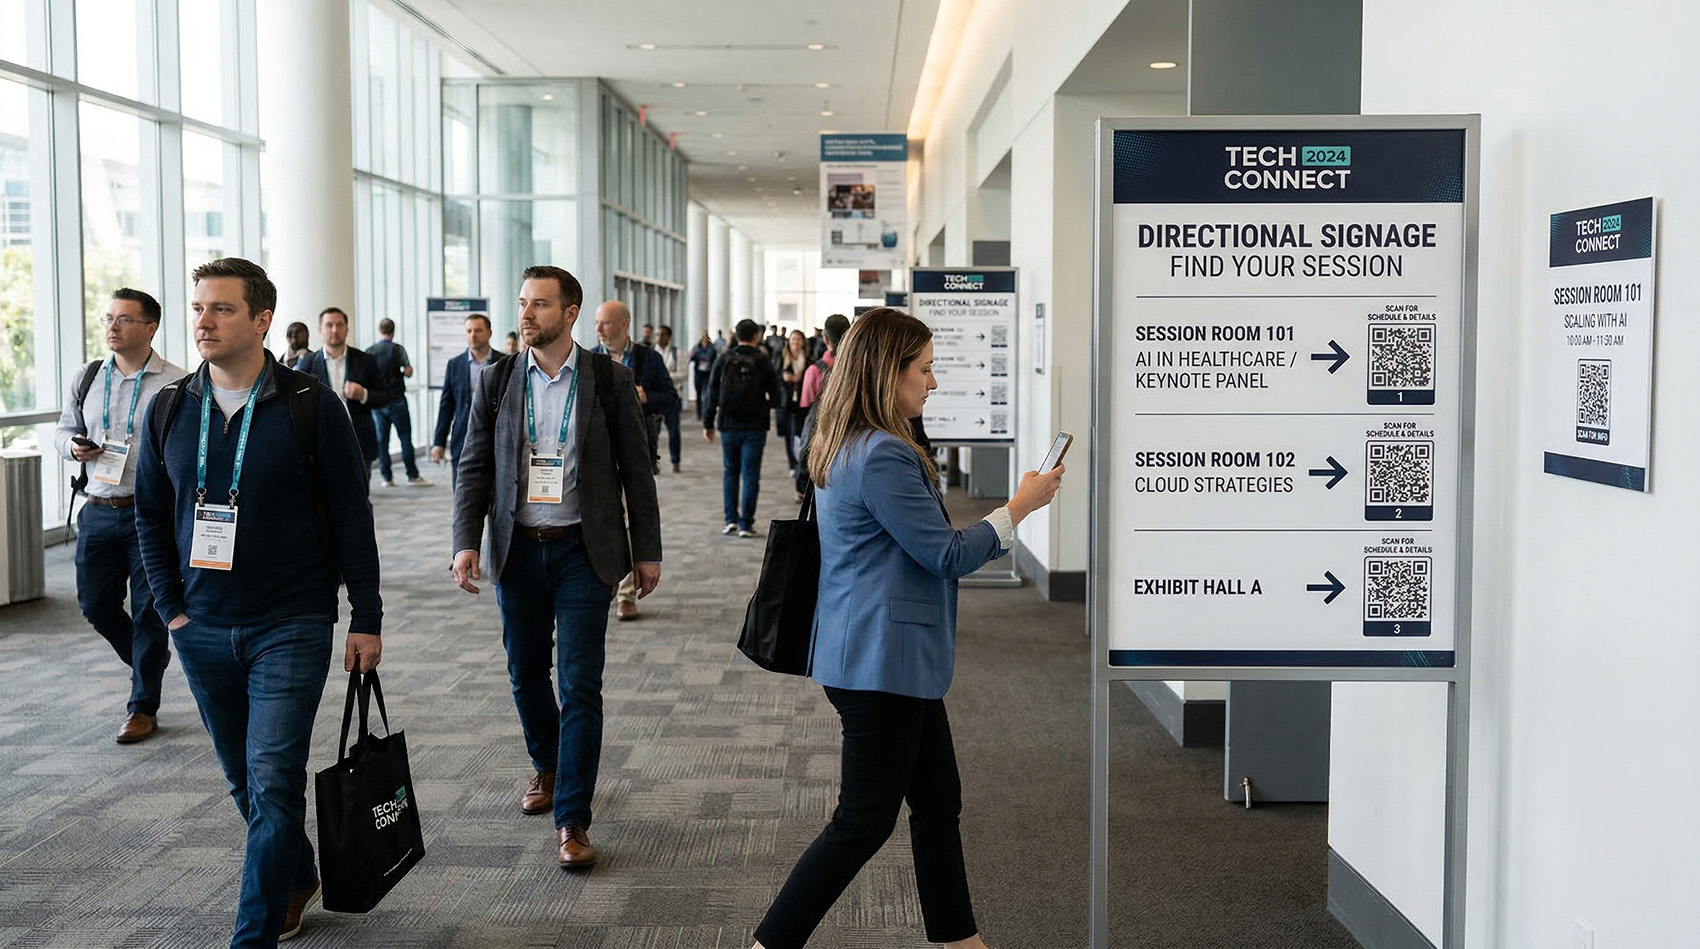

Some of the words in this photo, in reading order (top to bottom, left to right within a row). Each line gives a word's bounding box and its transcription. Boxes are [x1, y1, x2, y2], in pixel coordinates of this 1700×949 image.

[1225, 146, 1296, 167] TECH
[1306, 150, 1347, 163] 2024
[1224, 169, 1351, 189] CONNECT
[1575, 218, 1602, 236] TECH
[1138, 224, 1312, 249] DIRECTIONAL
[1320, 223, 1437, 248] SIGNAGE
[1575, 234, 1621, 254] CONNECT
[1171, 255, 1224, 277] FIND
[1231, 254, 1295, 277] YOUR
[1302, 254, 1402, 277] SESSION
[944, 275, 968, 283] TECH
[944, 282, 985, 290] CONNECT
[1553, 286, 1592, 306] SESSION
[1593, 284, 1622, 303] ROOM
[1625, 283, 1642, 302] 101
[919, 299, 972, 307] DIRECTIONAL
[974, 299, 1009, 307] SIGNAGE
[1385, 304, 1404, 312] SCAN
[1405, 304, 1419, 312] FOR
[1367, 313, 1402, 321] SCHEDULE
[1409, 313, 1437, 321] DETAILS
[1564, 313, 1596, 329] SCALING
[1597, 313, 1618, 328] WITH
[1619, 313, 1628, 327] AI
[1135, 325, 1206, 342] SESSION
[1211, 325, 1261, 342] ROOM
[1266, 325, 1294, 342] 101
[1135, 351, 1151, 367] AI
[1157, 351, 1173, 367] IN
[1179, 351, 1286, 367] HEALTHCARE
[1289, 351, 1298, 368] /
[1136, 372, 1211, 389] KEYNOTE
[1216, 372, 1268, 388] PANEL
[1397, 391, 1403, 402] 1
[1365, 430, 1400, 438] SCHEDULE
[1406, 430, 1435, 438] DETAILS
[1383, 422, 1402, 430] SCAN
[1403, 422, 1417, 430] FOR
[1135, 452, 1206, 468] SESSION
[1211, 452, 1261, 468] ROOM
[1266, 451, 1296, 468] 102
[1135, 476, 1189, 493] CLOUD
[1193, 476, 1294, 493] STRATEGIES
[1395, 508, 1402, 519] 2
[1381, 537, 1400, 545] SCAN
[1401, 537, 1415, 545] FOR
[1363, 546, 1398, 554] SCHEDULE
[1405, 546, 1433, 554] DETAILS
[1134, 579, 1200, 595] EXHIBIT
[1203, 579, 1246, 595] HALL
[1250, 579, 1263, 595] A
[1394, 623, 1401, 634] 3
[372, 798, 398, 818] TECH
